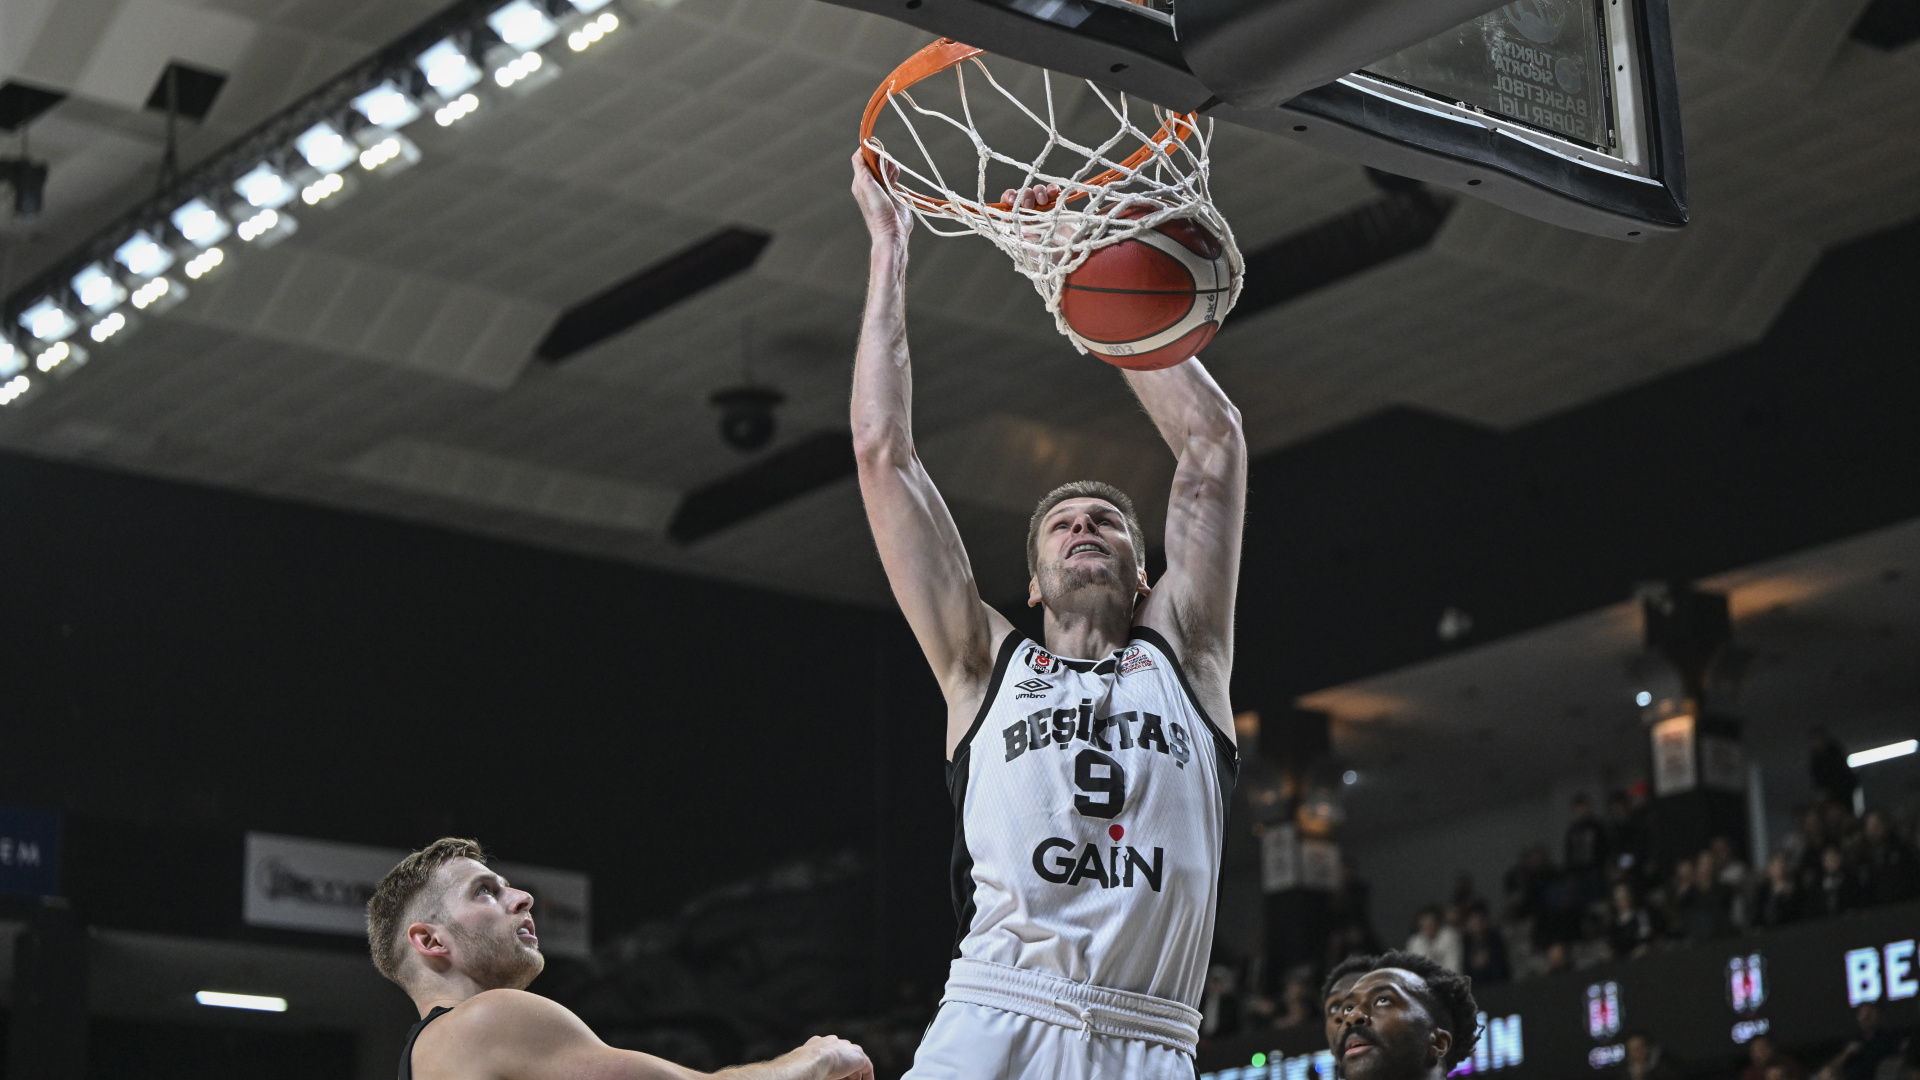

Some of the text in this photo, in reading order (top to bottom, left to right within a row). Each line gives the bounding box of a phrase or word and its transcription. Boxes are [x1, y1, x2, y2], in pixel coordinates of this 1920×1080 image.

[1015, 692, 1047, 700] umbro
[1002, 698, 1191, 770] BEŞİKTAŞ
[1074, 749, 1125, 819] 9
[1032, 836, 1164, 893] GAIN
